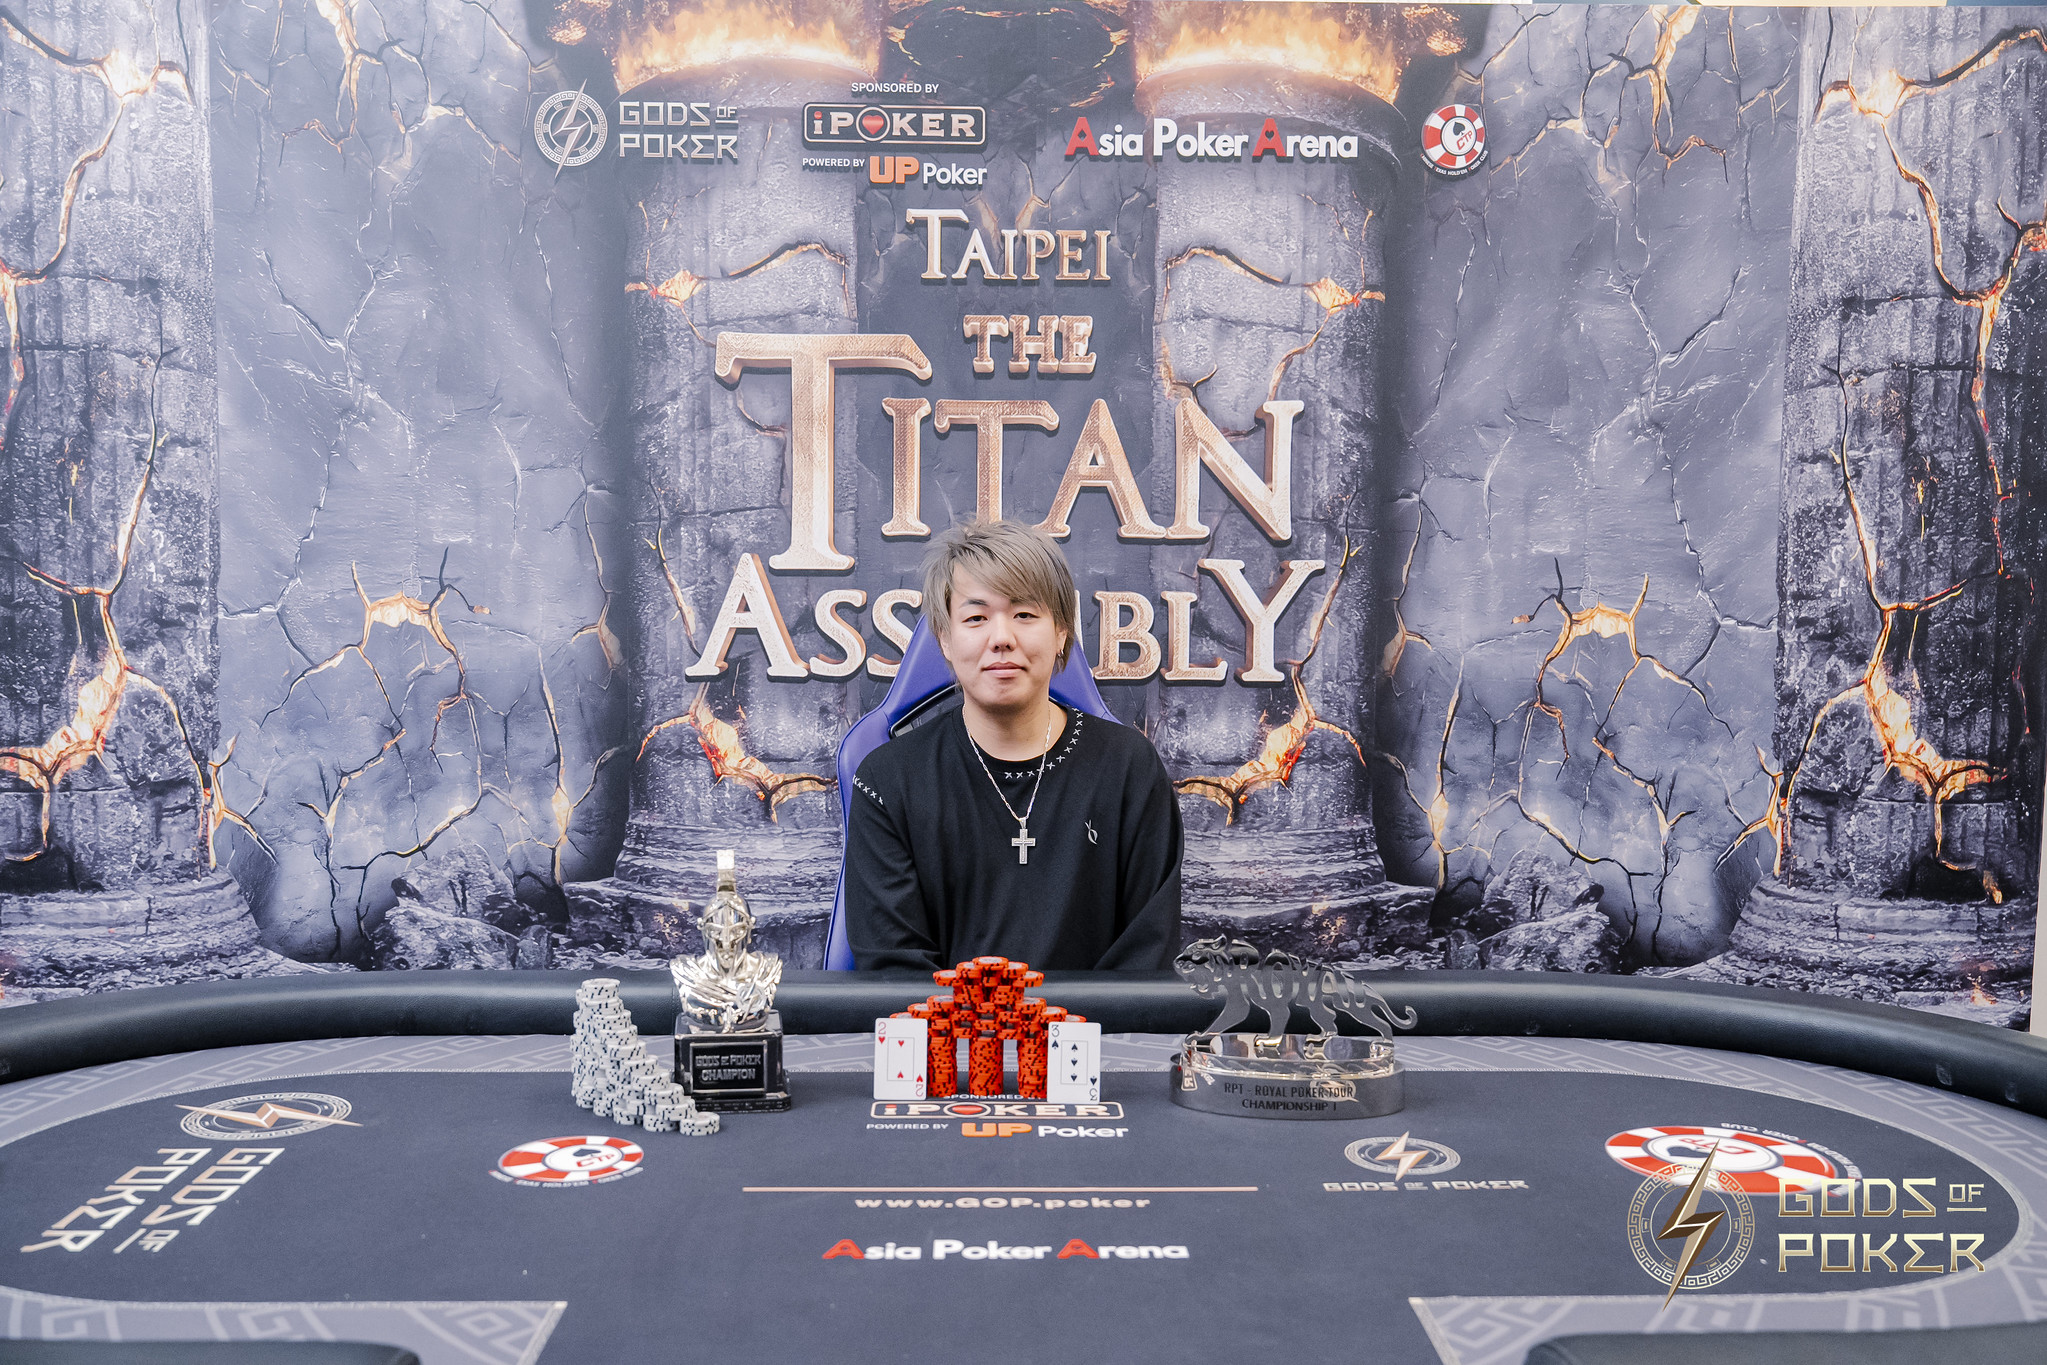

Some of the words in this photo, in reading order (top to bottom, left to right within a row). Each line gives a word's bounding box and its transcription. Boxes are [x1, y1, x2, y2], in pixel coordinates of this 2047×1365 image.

[851, 82, 922, 93] SPONSORED
[924, 83, 940, 94] BY
[619, 101, 711, 127] GODS
[717, 107, 738, 118] OF
[619, 133, 738, 159] POKER
[1065, 117, 1143, 156] Asia
[1153, 118, 1249, 157] Poker
[1252, 118, 1359, 158] Arena
[1456, 130, 1473, 151] CTP
[802, 157, 851, 167] POWERED
[853, 158, 865, 167] BY
[870, 156, 920, 183] UP
[923, 163, 988, 185] Poker
[1435, 166, 1447, 175] TEXAS
[1447, 168, 1468, 176] HOLD'EM
[1468, 160, 1481, 172] POKER
[1480, 150, 1489, 162] CLUB
[906, 208, 1111, 281] TAIPEI
[963, 315, 1097, 374] THE
[714, 331, 1305, 572] TITAN
[685, 552, 1326, 683] ASSBLY
[877, 1021, 887, 1036] 2
[1051, 1024, 1060, 1038] 3
[695, 1055, 720, 1067] GODS
[730, 1054, 761, 1065] POKER
[701, 1068, 756, 1081] CHAMPION
[1224, 1082, 1244, 1094] RPT
[1255, 1085, 1287, 1097] ROYAL
[1291, 1086, 1325, 1098] POKER
[1328, 1087, 1353, 1098] TOUR
[1242, 1099, 1328, 1112] CHAMPIONSHIP
[961, 1122, 1032, 1137] UP
[1038, 1125, 1129, 1138] Poker
[1720, 1122, 1758, 1132] CLUB
[576, 1153, 615, 1167] CTP
[140, 1147, 285, 1225] GODS
[1323, 1181, 1398, 1192] GODS
[1431, 1180, 1529, 1190] POKER
[20, 1147, 212, 1252] POKER
[855, 1197, 1151, 1210] www.GOP.poker
[822, 1238, 922, 1260] Asia
[932, 1238, 1052, 1260] Poker
[1056, 1238, 1190, 1260] Arena
